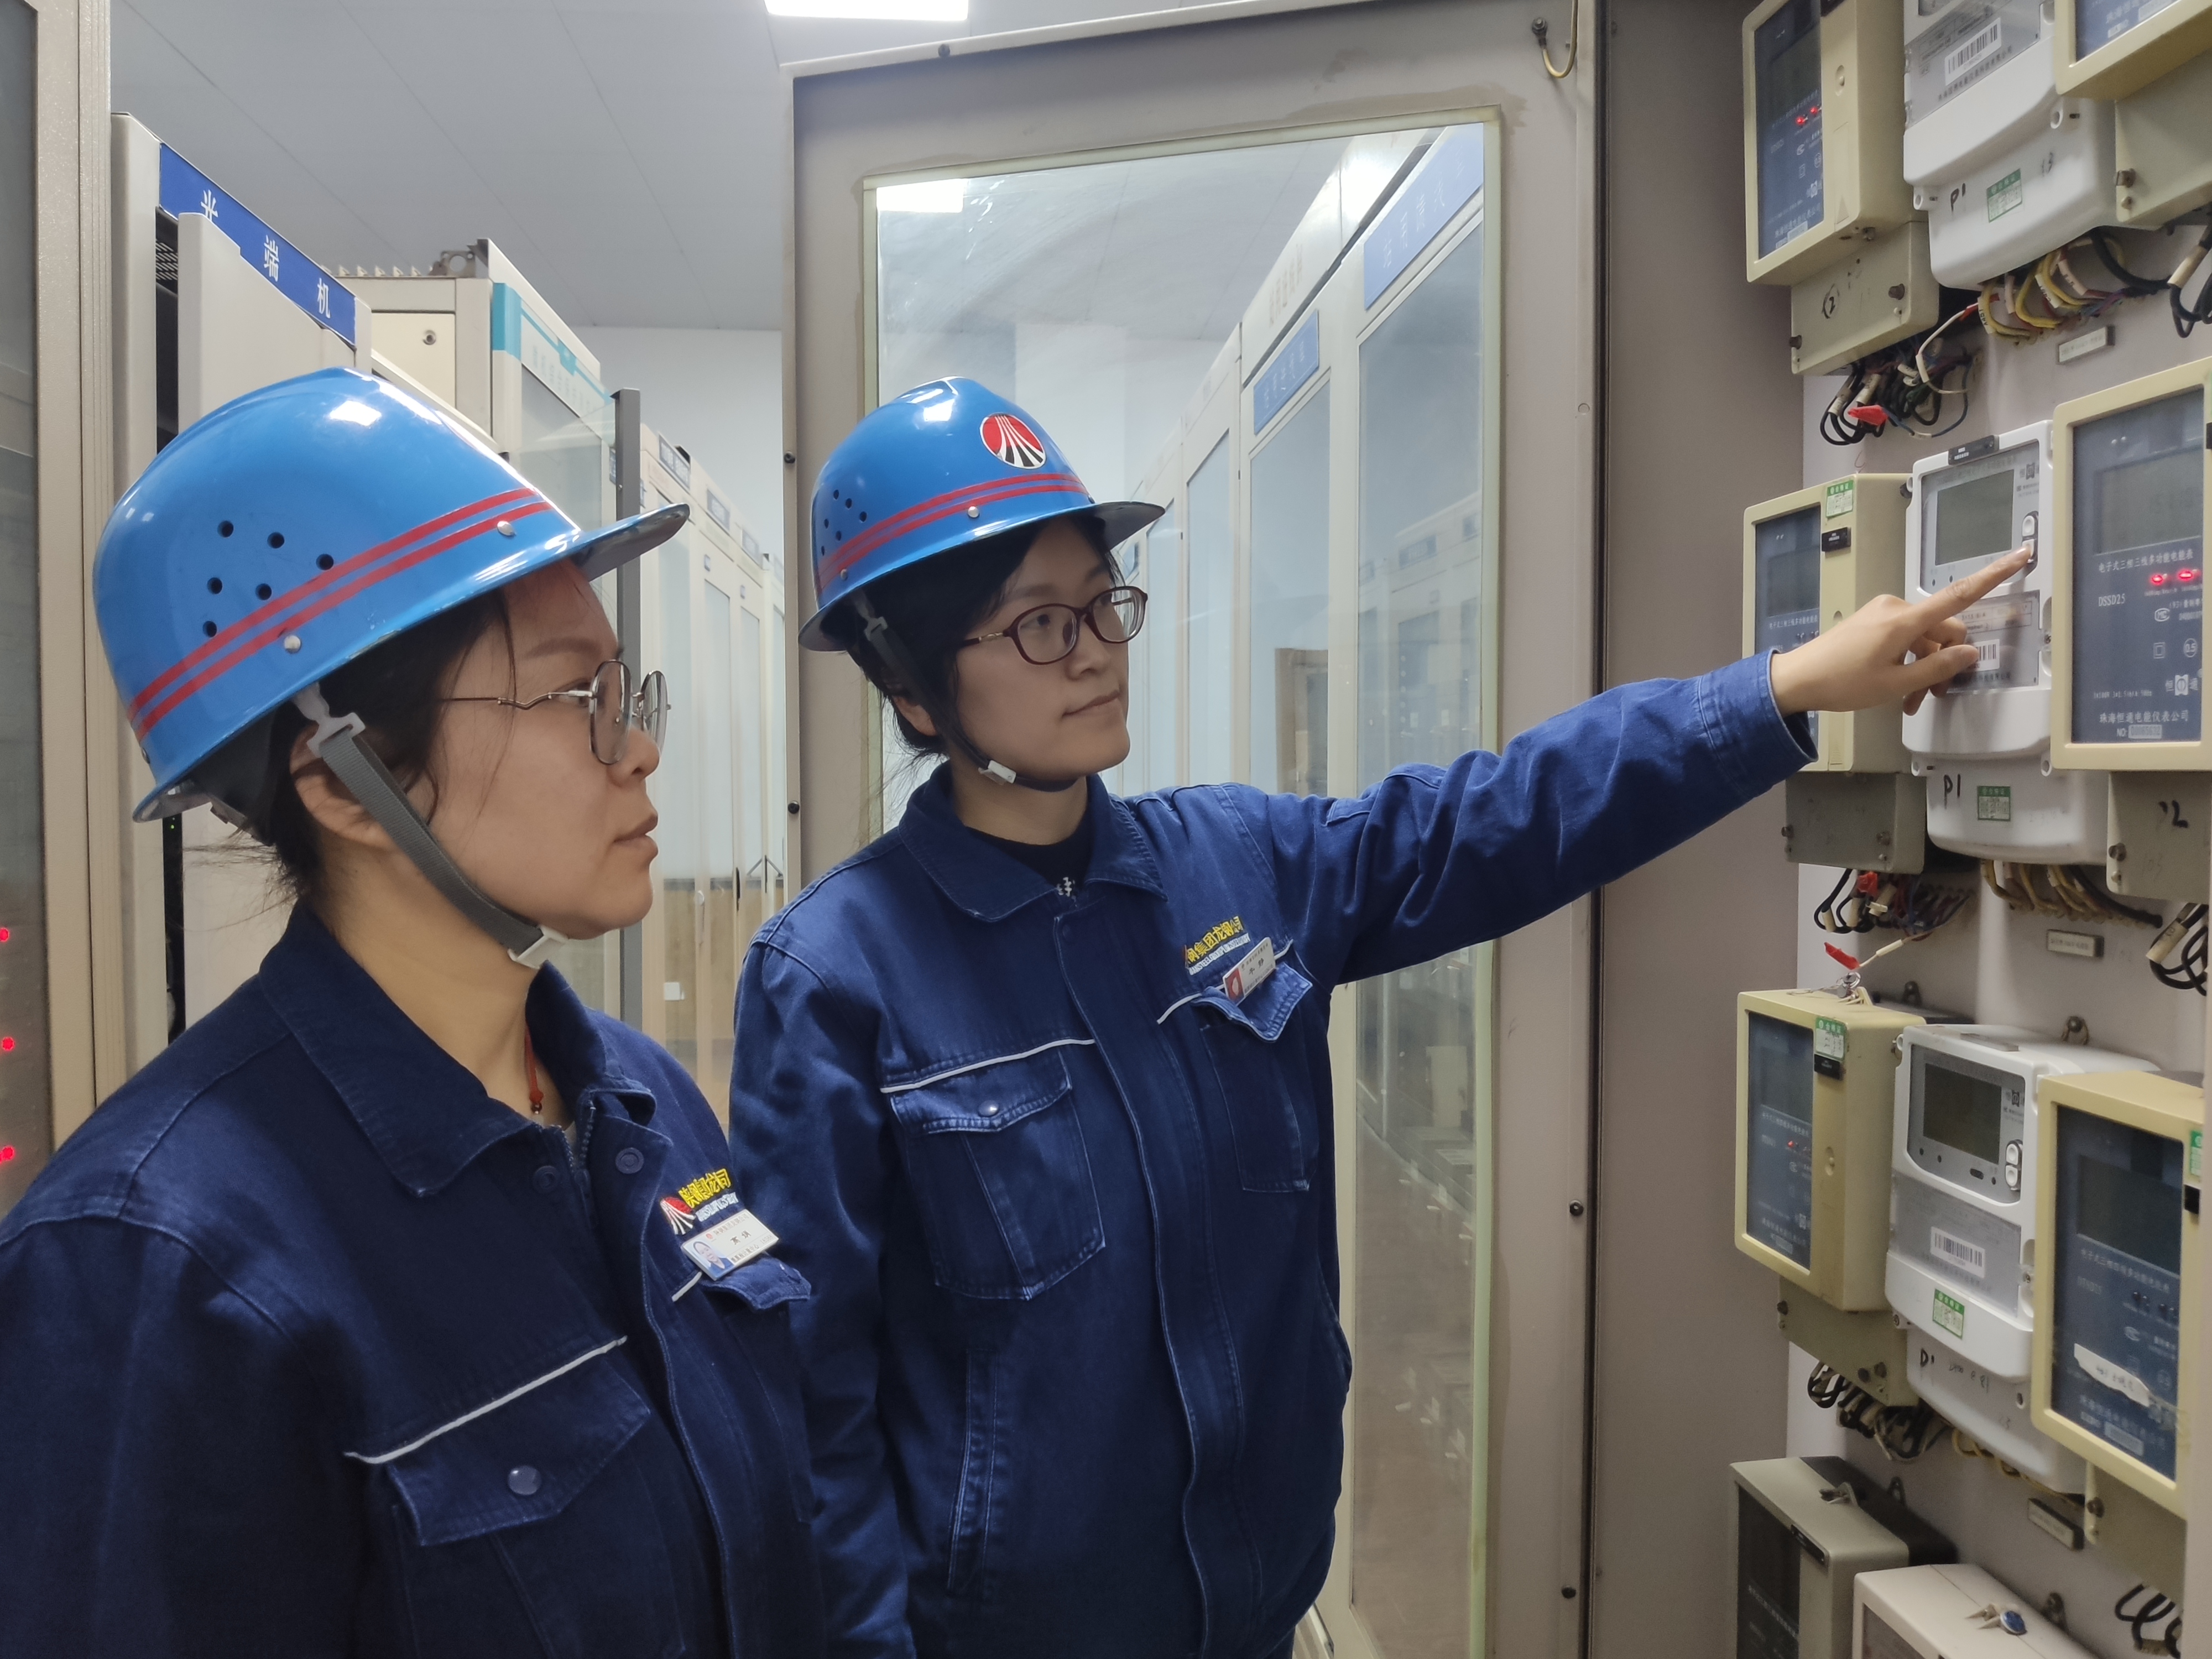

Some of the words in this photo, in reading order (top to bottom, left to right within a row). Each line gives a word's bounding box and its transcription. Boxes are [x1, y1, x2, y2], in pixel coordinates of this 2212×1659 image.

[2098, 548, 2194, 573] 电子式三相三线多功能电能表
[2098, 593, 2126, 607] DSSD25
[2099, 710, 2189, 723] 珠海恒通电能仪表公司
